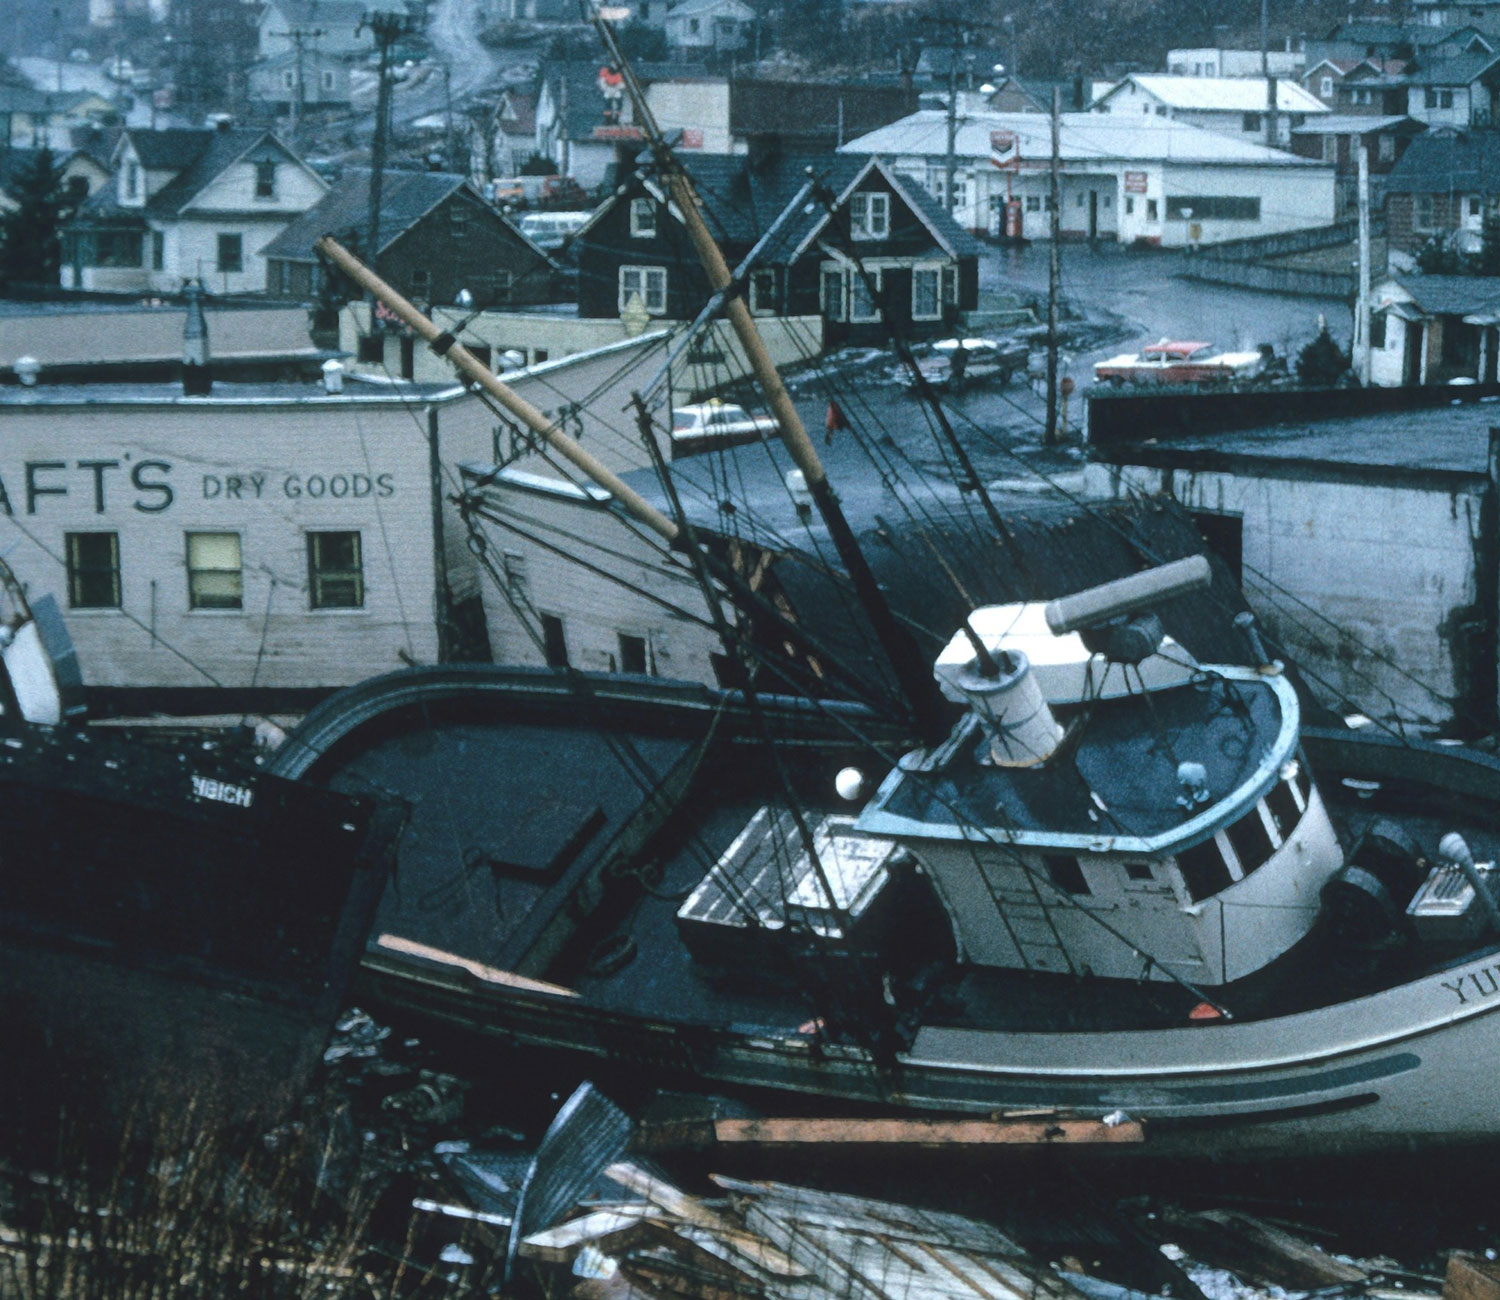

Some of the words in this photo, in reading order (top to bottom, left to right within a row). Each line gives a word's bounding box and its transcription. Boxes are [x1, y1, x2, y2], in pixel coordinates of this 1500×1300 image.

[0, 452, 174, 516] FT'S
[203, 473, 265, 499] DRY
[283, 473, 395, 499] GOODS
